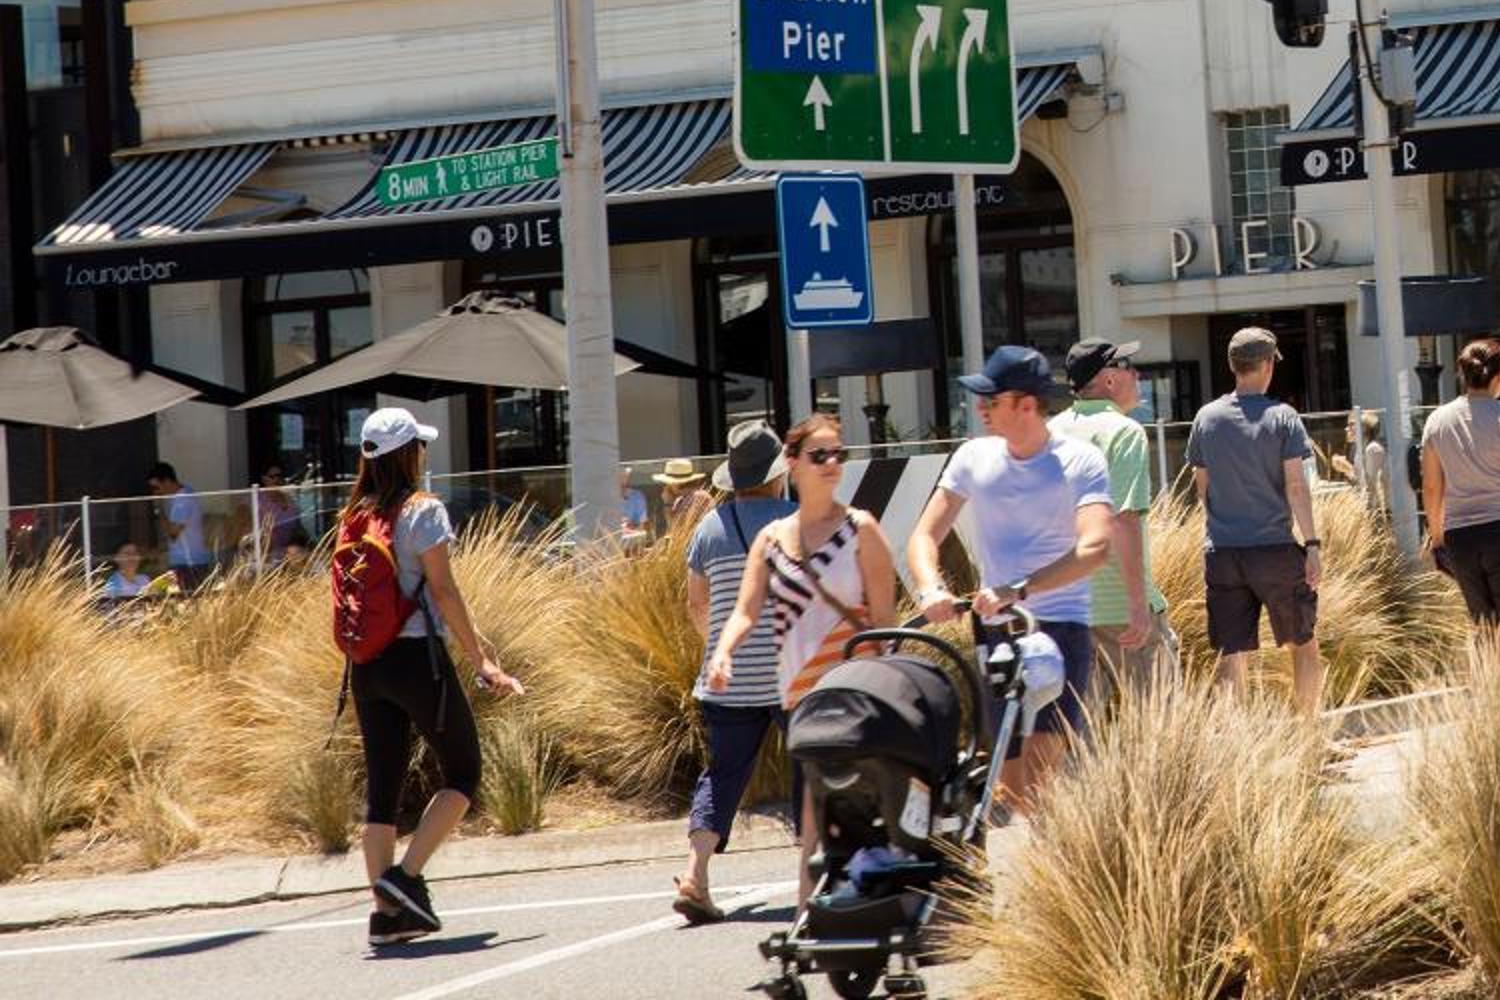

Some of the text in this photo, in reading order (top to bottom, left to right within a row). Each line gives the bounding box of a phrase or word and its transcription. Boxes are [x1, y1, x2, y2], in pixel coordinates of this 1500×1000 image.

[782, 21, 845, 61] Pier
[451, 144, 547, 175] TO STATION PIER
[388, 173, 429, 200] 8 MIN
[475, 168, 507, 190] LIGHT
[512, 163, 540, 183] RAIL
[872, 185, 1004, 216] restaunt
[504, 218, 553, 249] PIE
[1169, 216, 1319, 281] PIER
